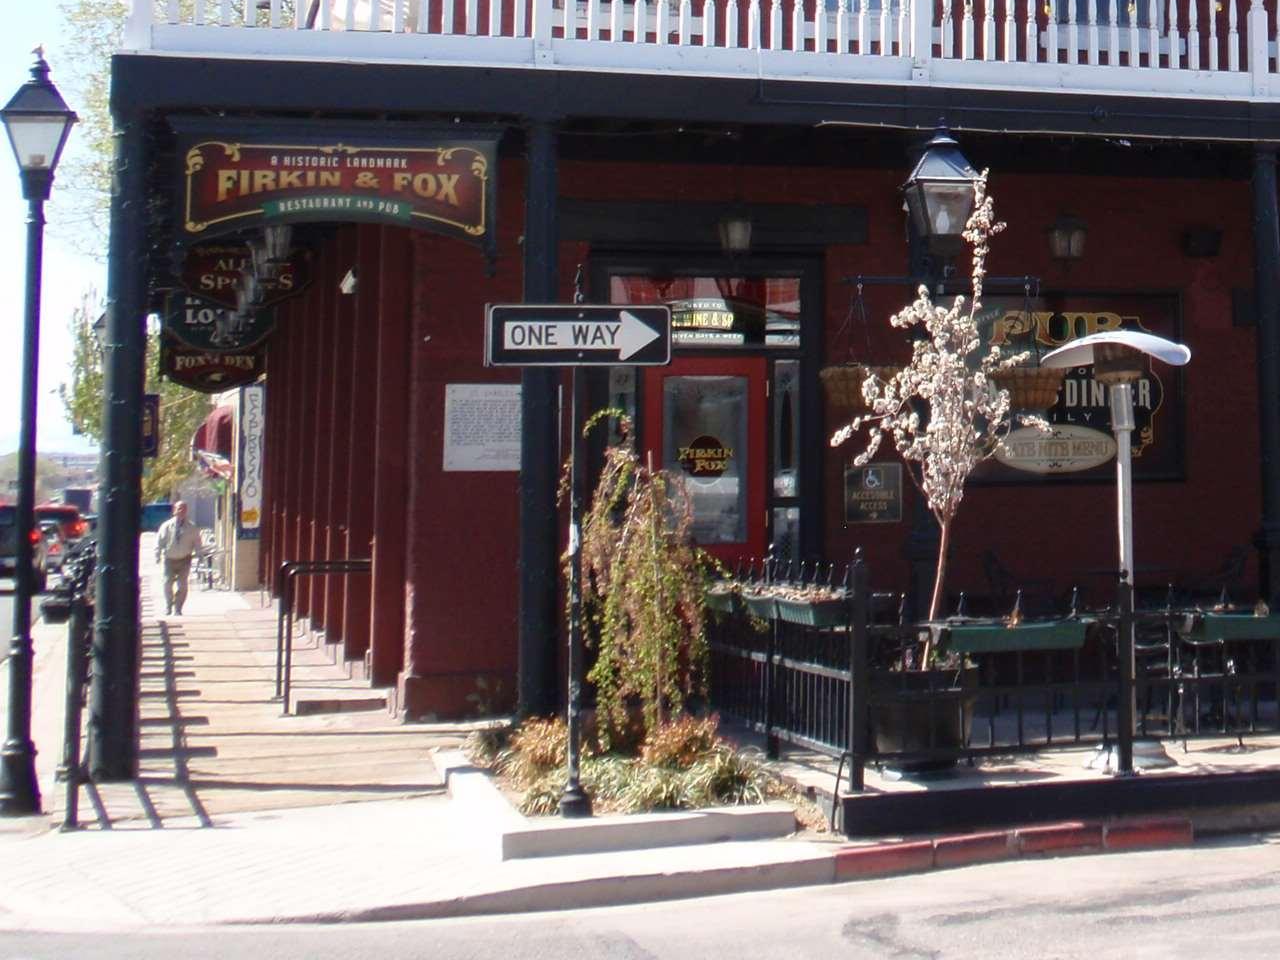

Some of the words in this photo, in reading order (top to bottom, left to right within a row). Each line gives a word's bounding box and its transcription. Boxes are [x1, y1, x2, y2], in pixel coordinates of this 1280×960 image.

[271, 156, 278, 167] A
[284, 156, 339, 168] HISTORIC
[347, 157, 407, 169] LANDMARK
[217, 170, 341, 202] FIRKIN
[355, 171, 380, 189] &
[393, 172, 460, 206] FOX
[279, 198, 351, 212] RESTAURANT
[378, 200, 400, 214] PUB
[511, 325, 558, 346] ONE
[572, 325, 621, 346] WAY
[987, 311, 1123, 346] PUB
[1065, 378, 1151, 409] DINR
[677, 447, 735, 461] FIRKIN
[694, 458, 729, 473] FOX
